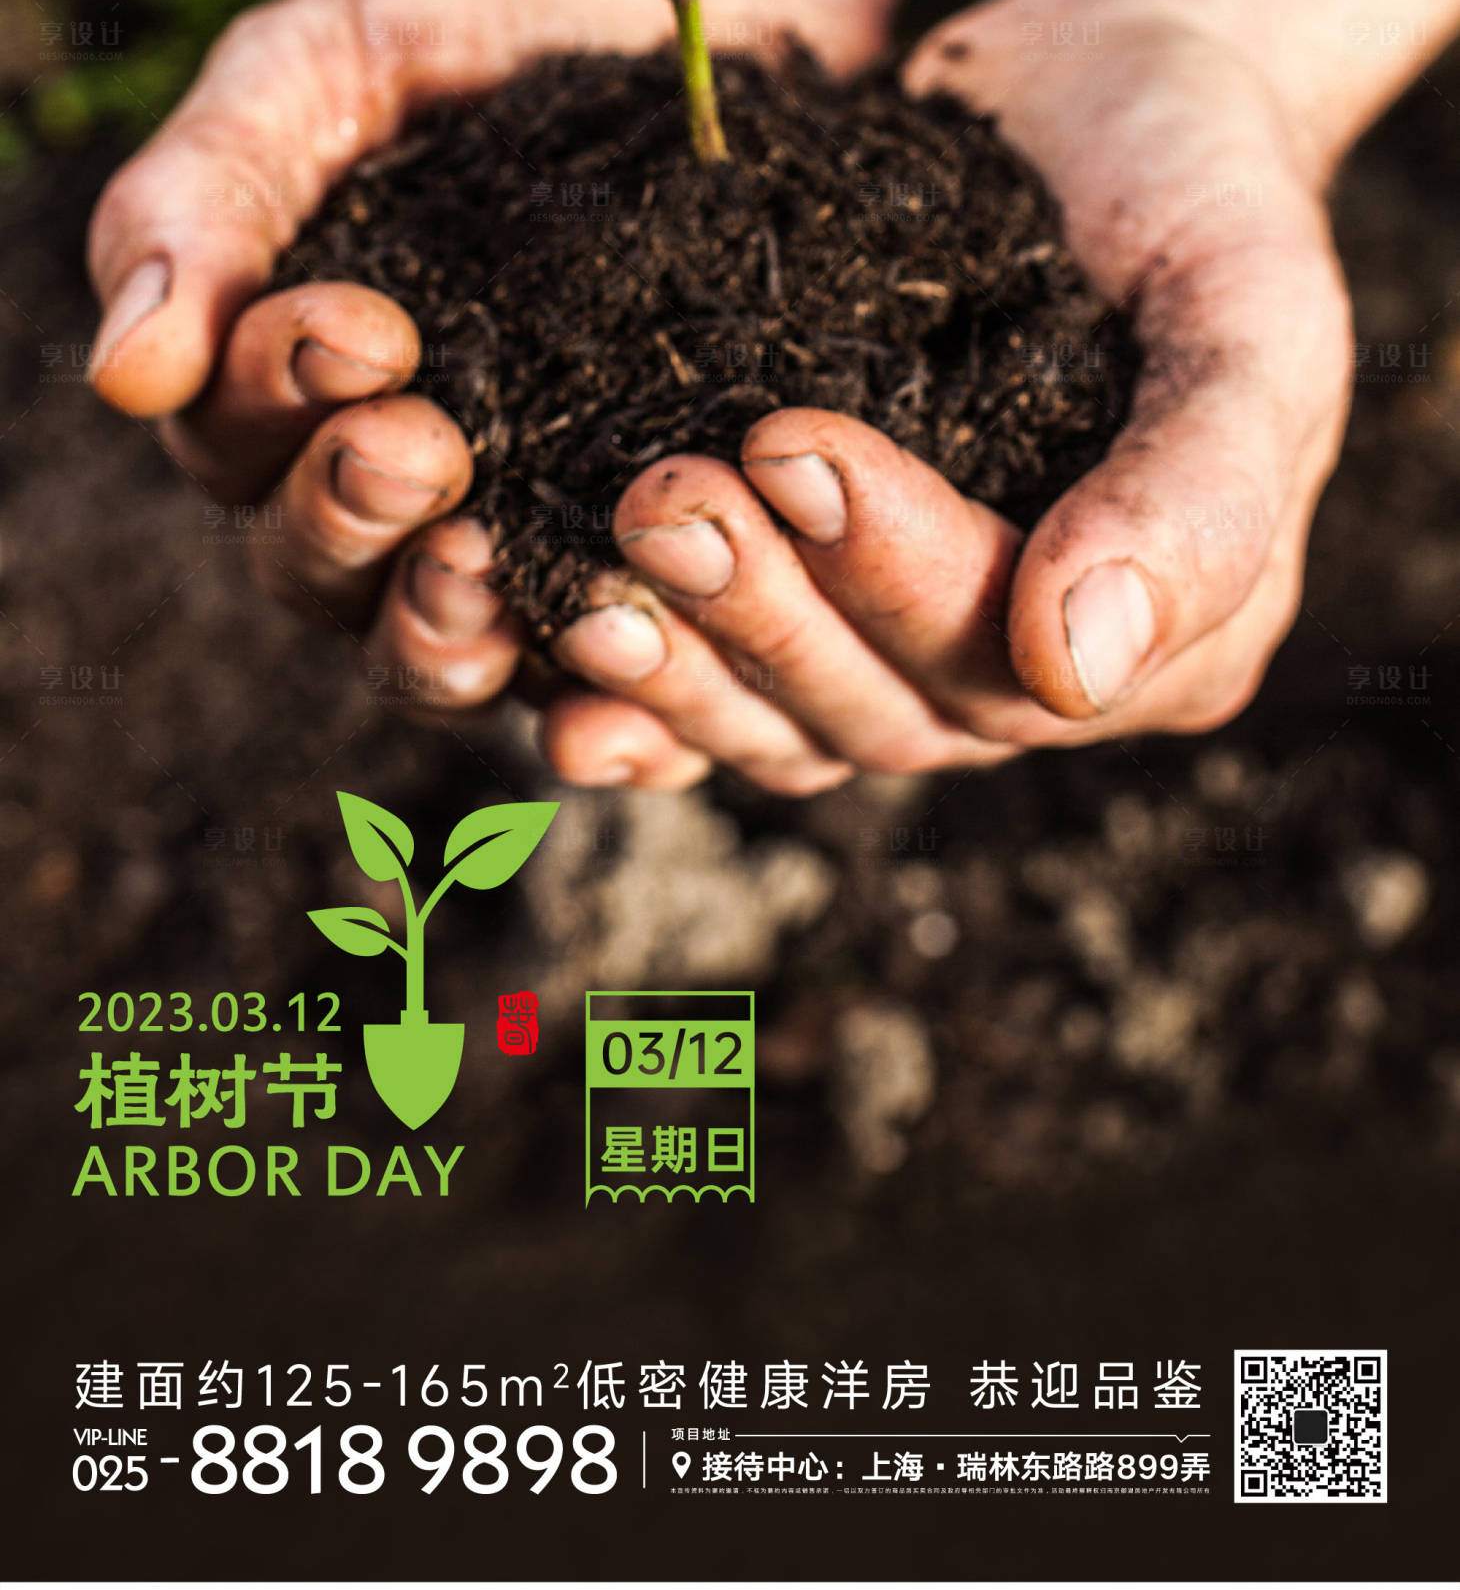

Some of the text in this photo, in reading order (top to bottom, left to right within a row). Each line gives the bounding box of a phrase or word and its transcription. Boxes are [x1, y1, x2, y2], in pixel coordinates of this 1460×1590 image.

[78, 992, 341, 1031] 2023.03.12
[602, 1030, 743, 1078] 03/12
[74, 1051, 343, 1129] 植树节
[72, 1145, 465, 1196] ARBOR DAY
[601, 1124, 745, 1173] 星期日
[971, 1358, 1202, 1410] 恭迎品鉴
[73, 1427, 148, 1445] VIP-LINE
[671, 1427, 731, 1440] 项目地址
[408, 1423, 618, 1494] 9898
